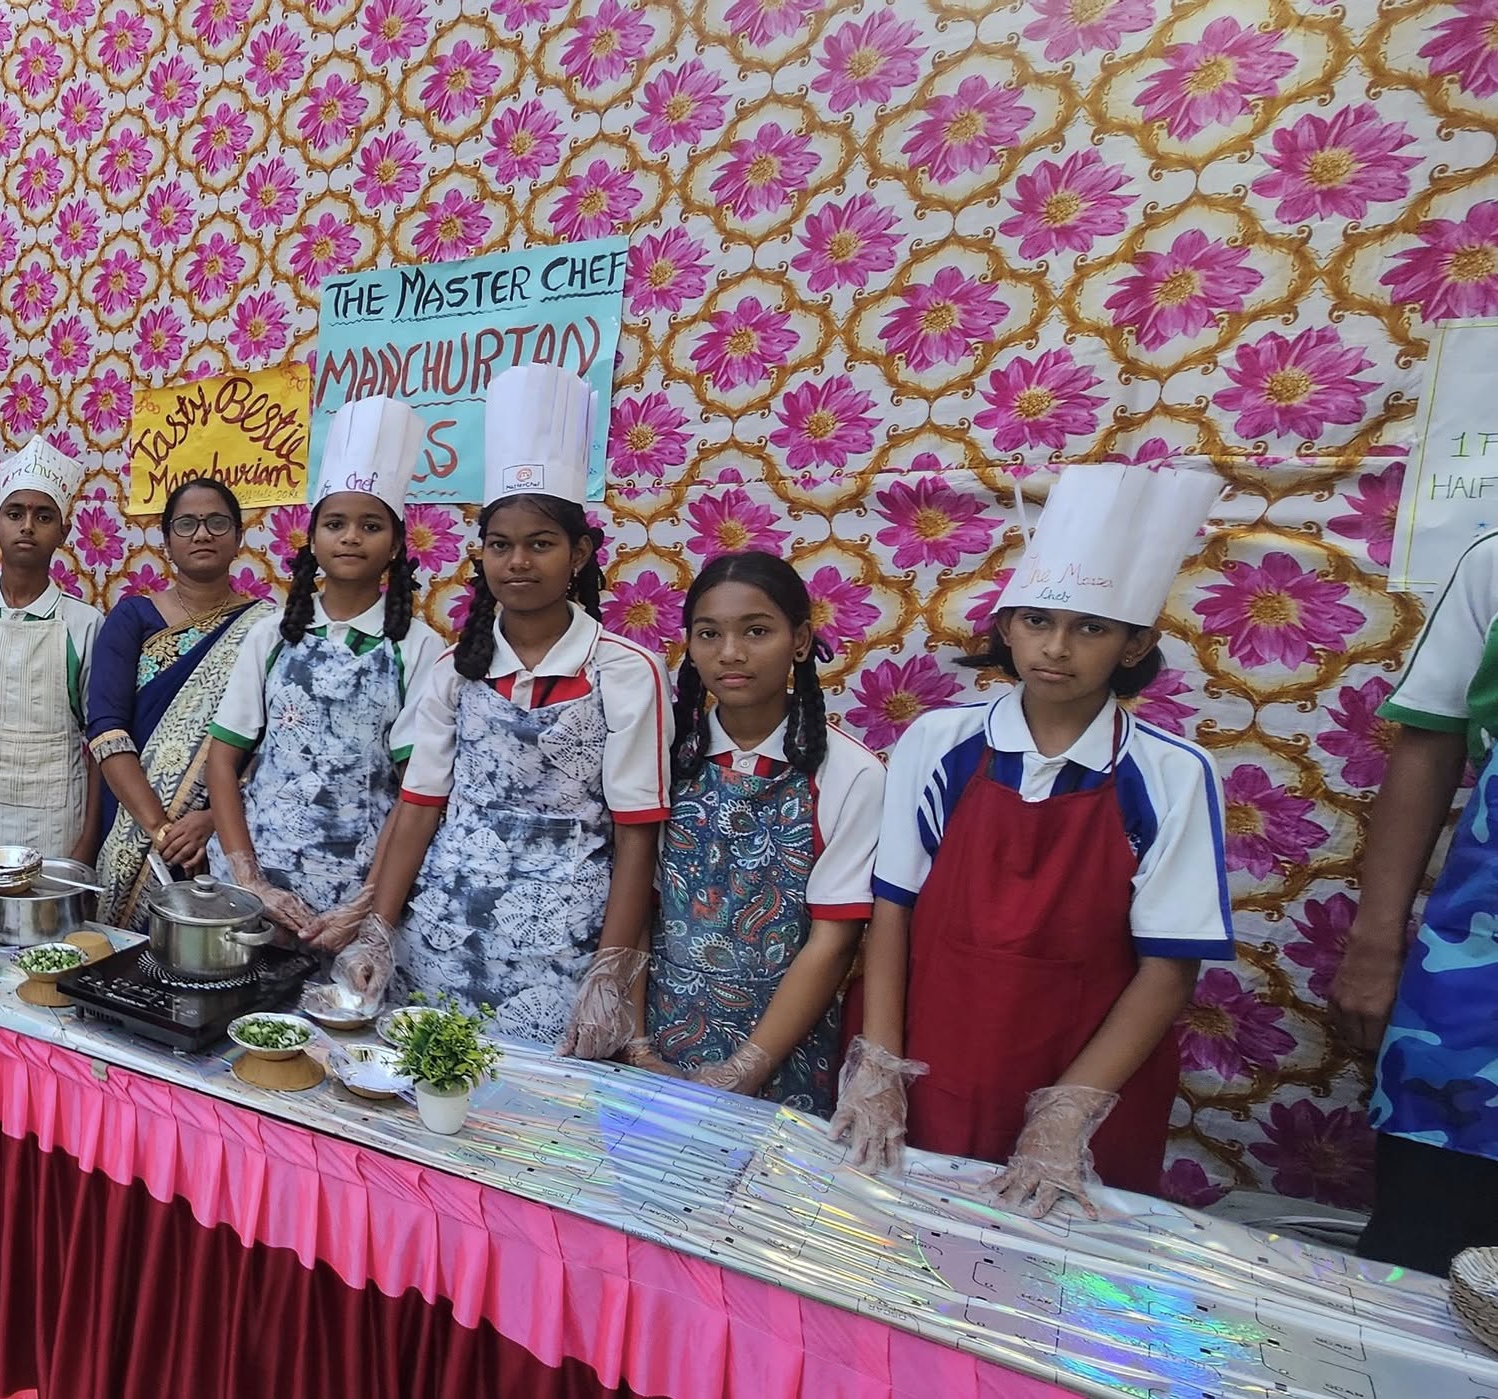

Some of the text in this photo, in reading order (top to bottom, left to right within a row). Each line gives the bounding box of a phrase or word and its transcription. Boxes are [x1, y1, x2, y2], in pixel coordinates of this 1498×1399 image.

[325, 250, 628, 318] THE MASTER CHEF
[131, 385, 211, 469] Tasty
[1451, 432, 1470, 457] 1
[1431, 473, 1498, 500] HALF
